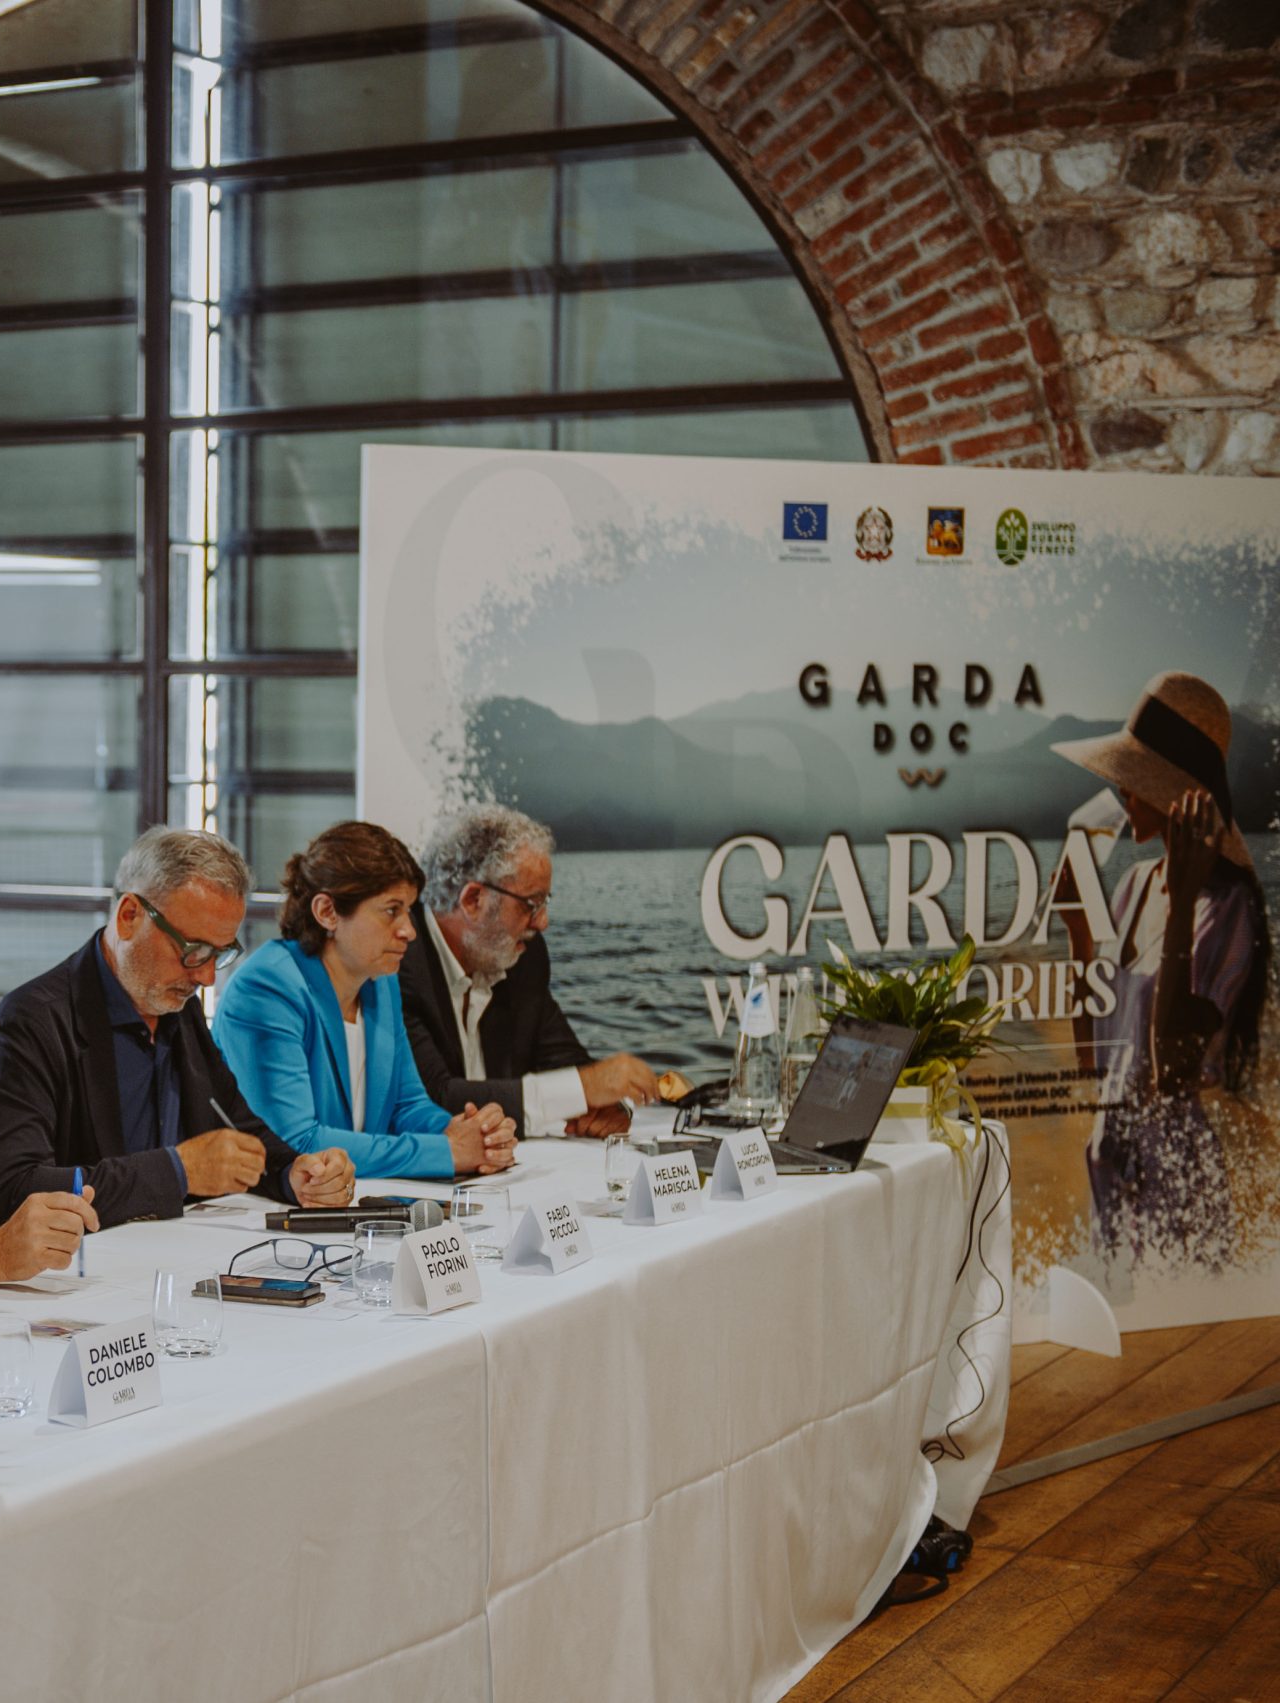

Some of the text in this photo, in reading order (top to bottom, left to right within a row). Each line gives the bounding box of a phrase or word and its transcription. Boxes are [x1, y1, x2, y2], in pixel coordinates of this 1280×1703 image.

[1032, 545, 1076, 555] VENETO
[798, 663, 1043, 705] GARDA
[873, 721, 969, 753] DOC
[700, 828, 1117, 959] GARDA
[1014, 1087, 1048, 1100] GARDA
[1050, 1086, 1072, 1098] DOC
[740, 1142, 759, 1156] LUCIO
[654, 1164, 691, 1182] HELENA
[653, 1178, 698, 1198] MARISCAL
[546, 1204, 571, 1224] FABIO
[549, 1219, 580, 1242] PICCOLI
[421, 1236, 460, 1260] PAOLO
[427, 1254, 469, 1279] FIORINI
[89, 1332, 147, 1365] DANIELE
[87, 1352, 155, 1387] COLOMBO
